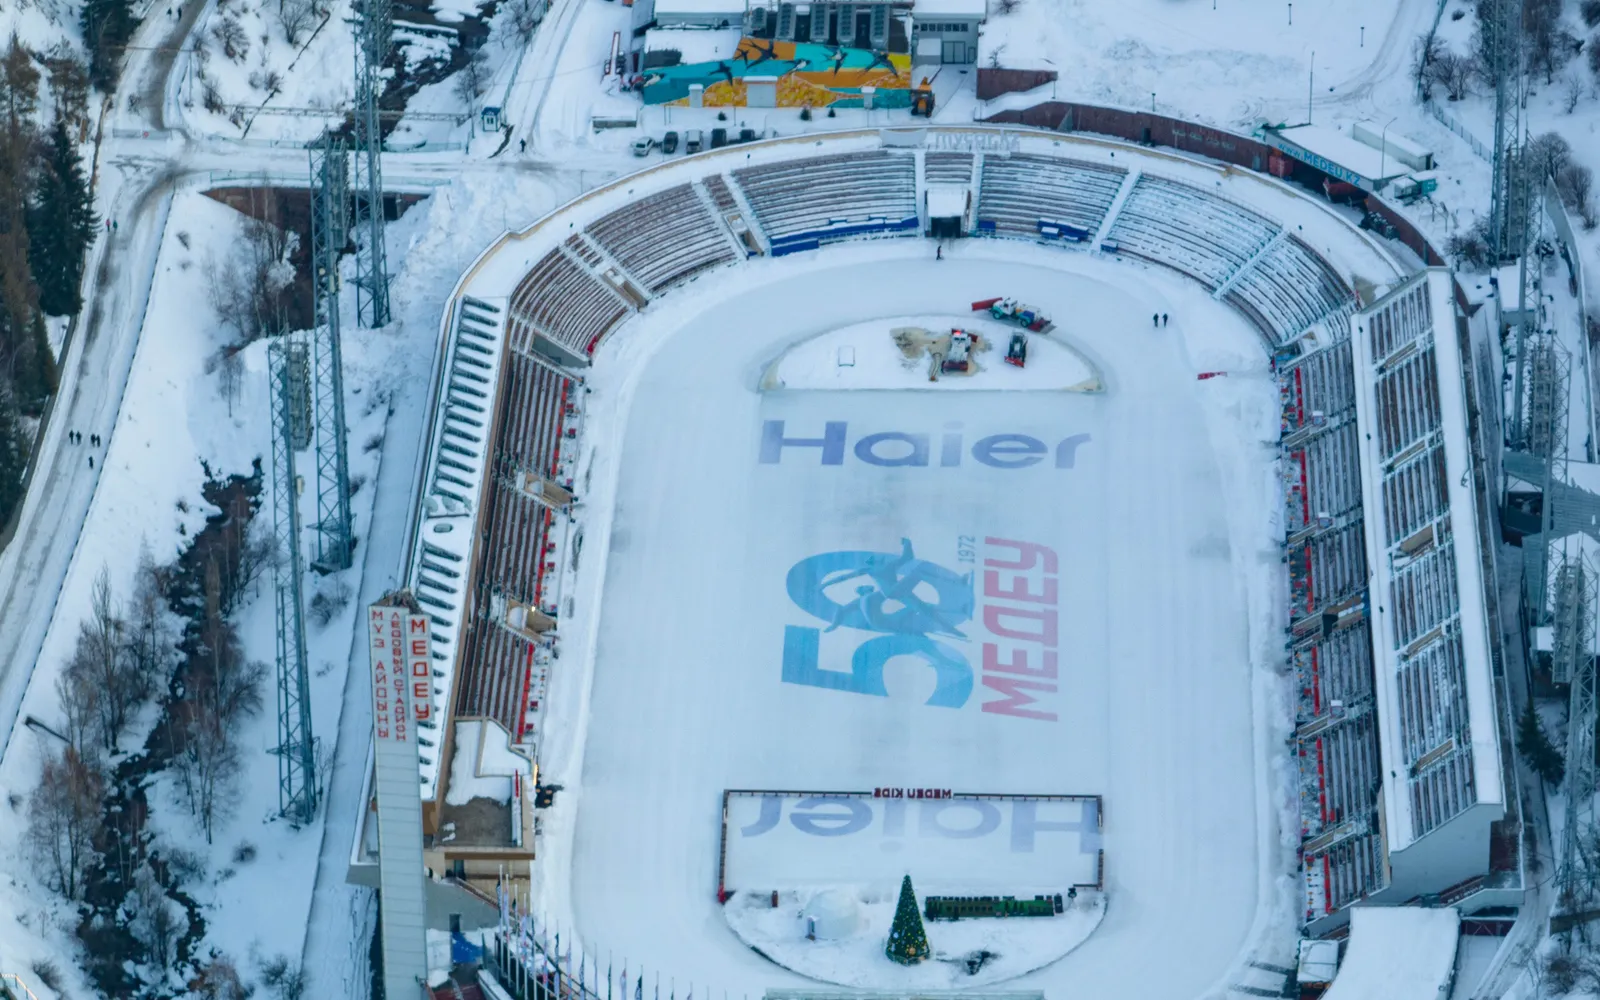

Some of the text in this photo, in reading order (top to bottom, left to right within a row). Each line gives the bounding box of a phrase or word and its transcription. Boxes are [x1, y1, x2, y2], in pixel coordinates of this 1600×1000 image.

[758, 420, 1092, 469] Haier
[958, 535, 976, 564] 1972
[781, 538, 976, 709] 50
[981, 536, 1058, 722] МЕДЕУ
[375, 658, 389, 738] АЙДЫНЫ
[391, 612, 406, 742] ЛЕДОВЫЙ СТАДИОН
[411, 619, 429, 719] МЕДЕУ
[741, 797, 1104, 853] Haier
